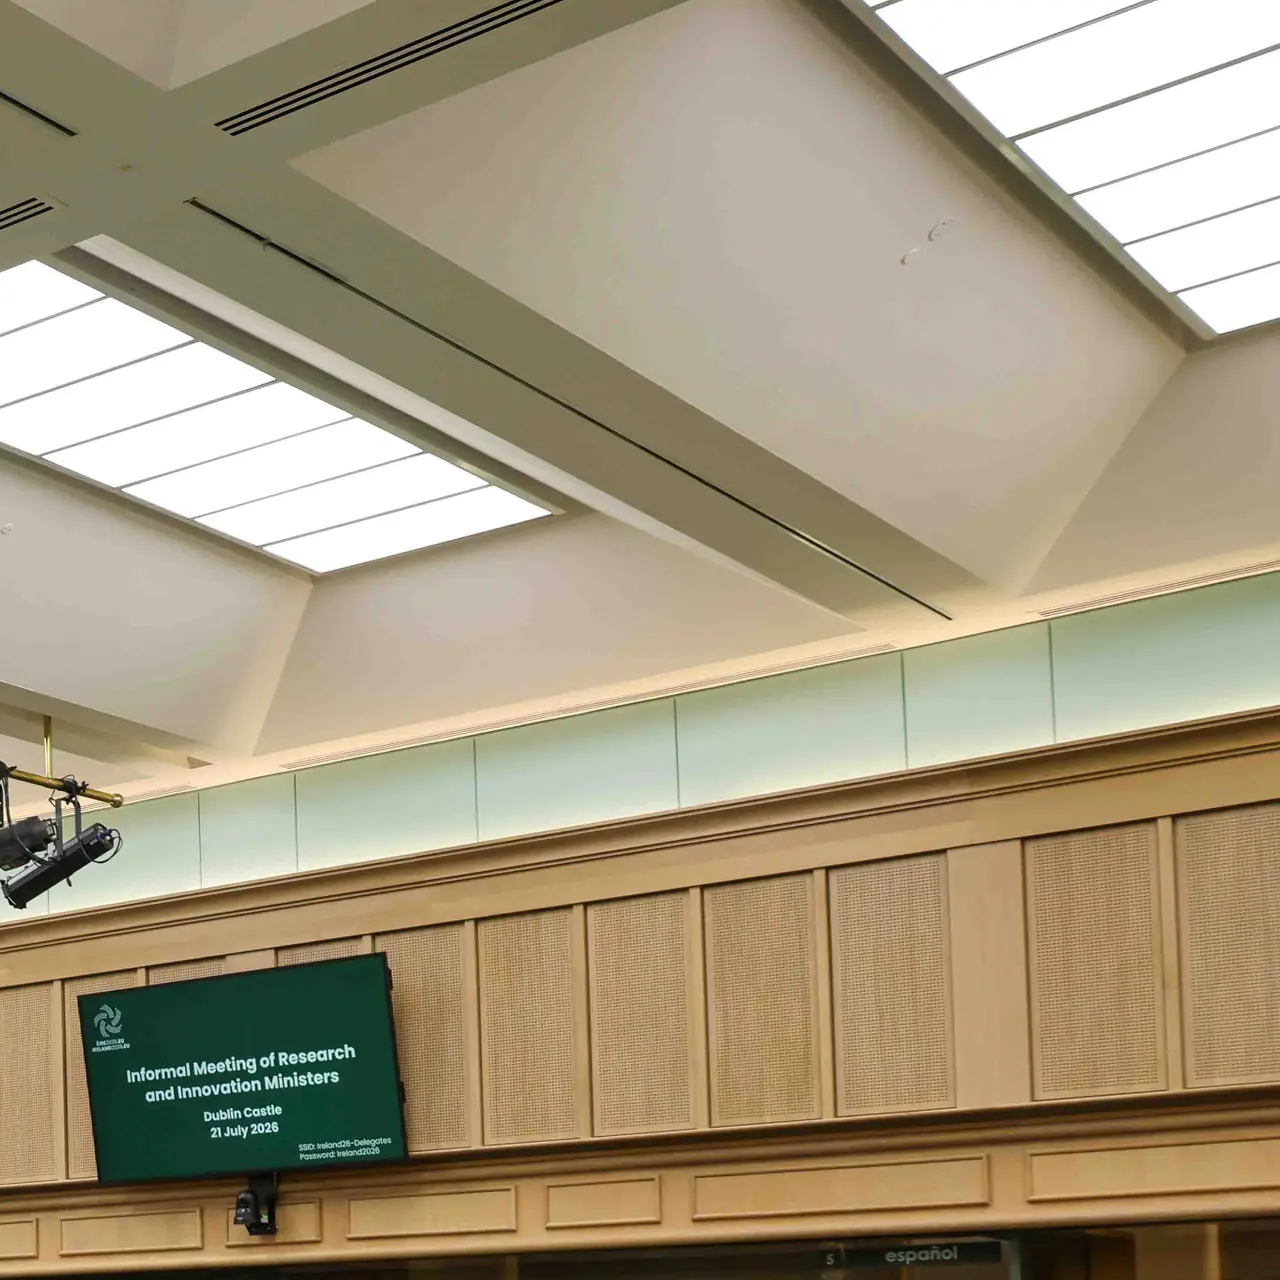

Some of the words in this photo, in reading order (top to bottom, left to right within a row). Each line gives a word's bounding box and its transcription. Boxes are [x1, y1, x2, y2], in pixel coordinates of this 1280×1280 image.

[126, 1063, 190, 1083] Informal
[193, 1056, 257, 1076] Meeting
[260, 1052, 276, 1068] of
[278, 1044, 356, 1066] Research
[145, 1087, 175, 1102] and
[177, 1078, 261, 1100] Innovation
[264, 1070, 340, 1091] Ministers
[203, 1107, 242, 1122] Dublin
[244, 1104, 283, 1118] Castle
[210, 1127, 222, 1138] 21
[223, 1125, 248, 1139] July
[251, 1122, 279, 1135] 2026
[299, 1143, 316, 1151] SSID:
[317, 1137, 392, 1150] Ireland26-Delegates
[299, 1151, 336, 1160] Password:
[337, 1147, 380, 1157] Ireland2026
[825, 1254, 835, 1265] 5
[884, 1245, 958, 1264] español
